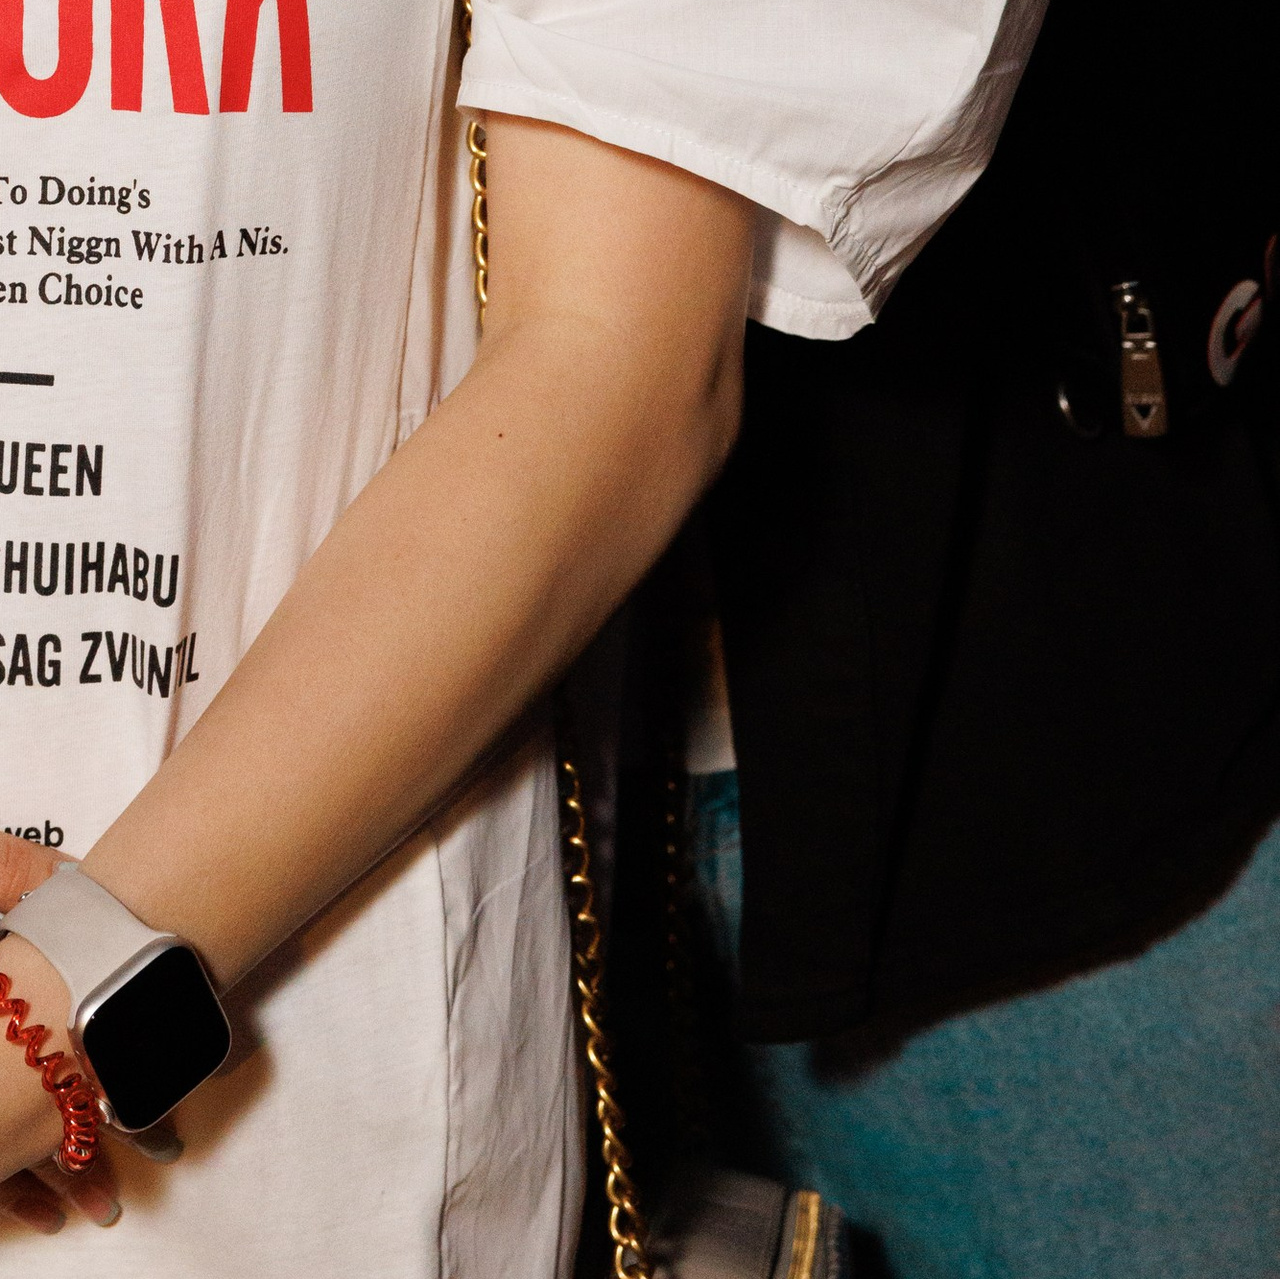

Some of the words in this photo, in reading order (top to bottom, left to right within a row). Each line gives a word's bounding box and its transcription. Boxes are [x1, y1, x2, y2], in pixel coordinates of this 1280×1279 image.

[38, 175, 151, 215] Doing's
[26, 225, 122, 265] Niggn
[235, 225, 289, 258] Nis.
[38, 271, 144, 310] Choice
